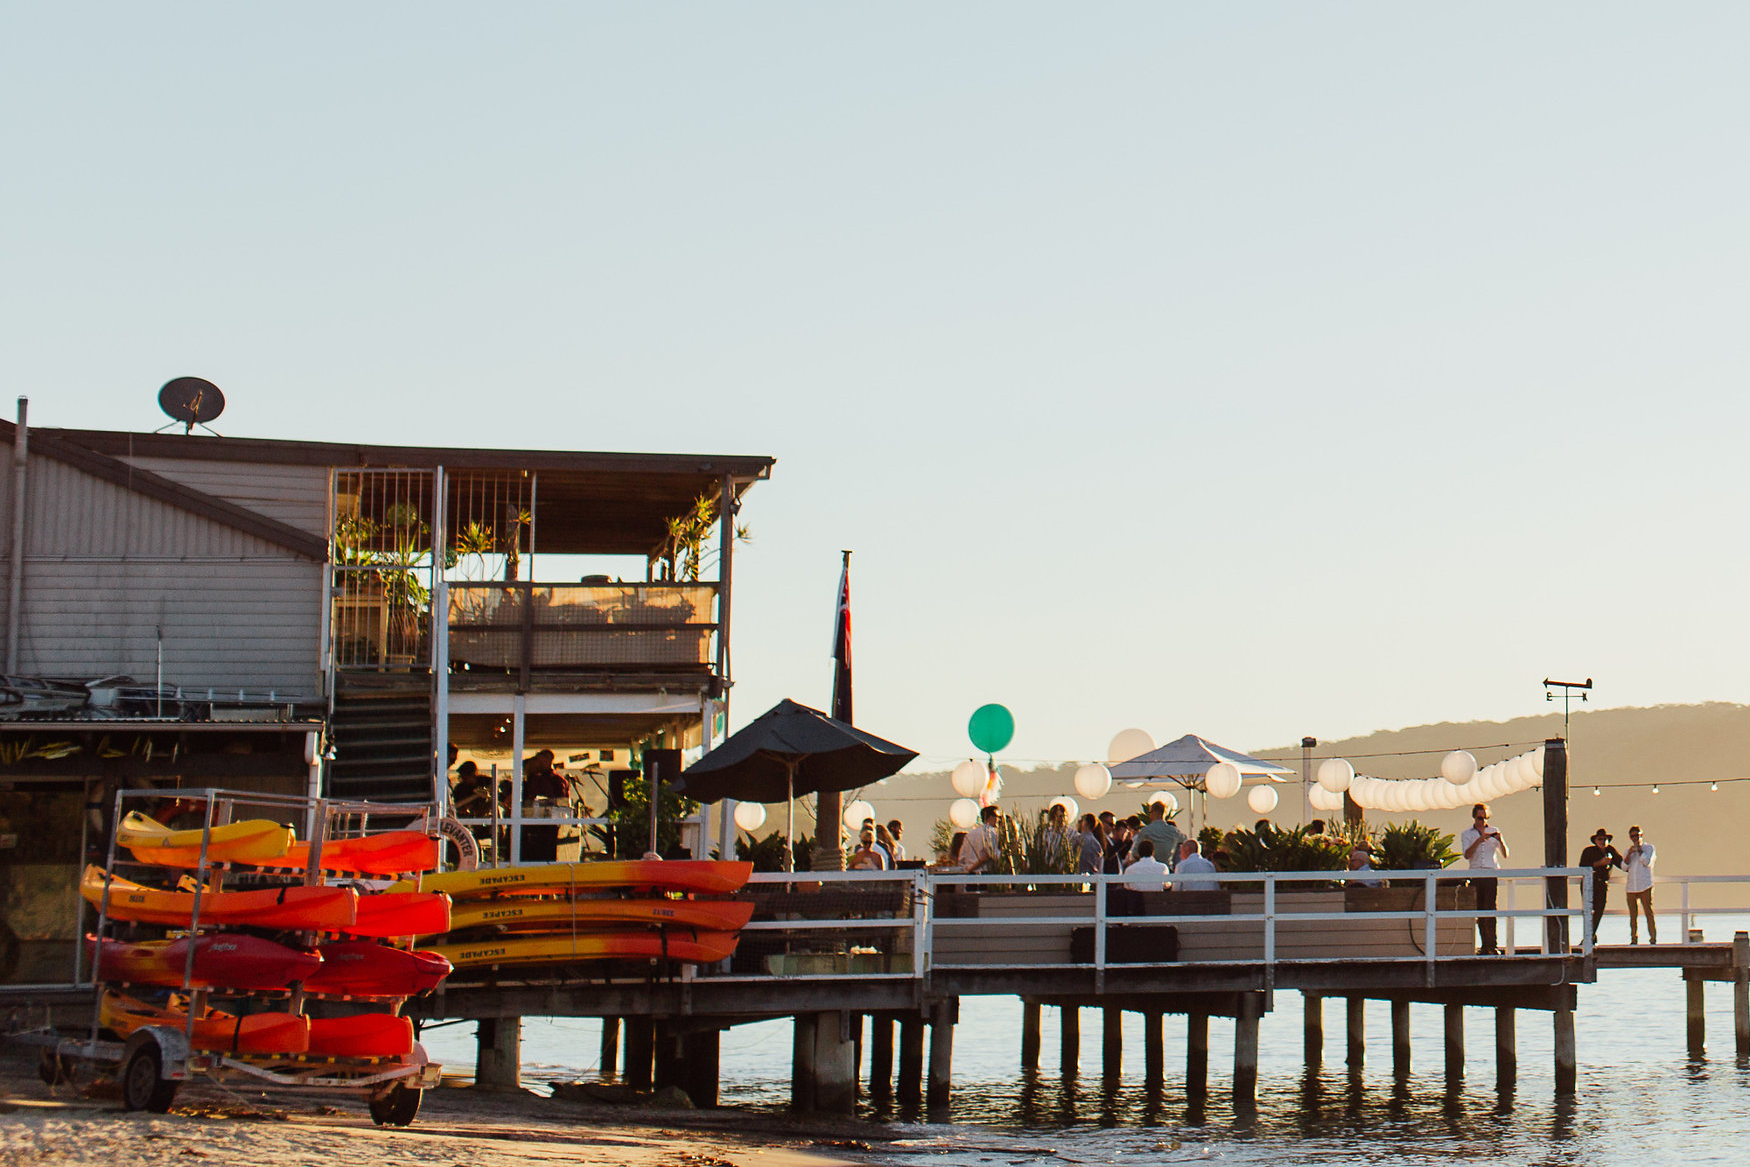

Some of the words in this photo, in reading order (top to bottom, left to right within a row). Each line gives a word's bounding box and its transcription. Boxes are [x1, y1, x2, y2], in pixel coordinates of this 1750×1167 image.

[440, 821, 473, 857] LEVANTER
[480, 874, 525, 885] ESCAPADE
[460, 948, 506, 959] ESCAPADE
